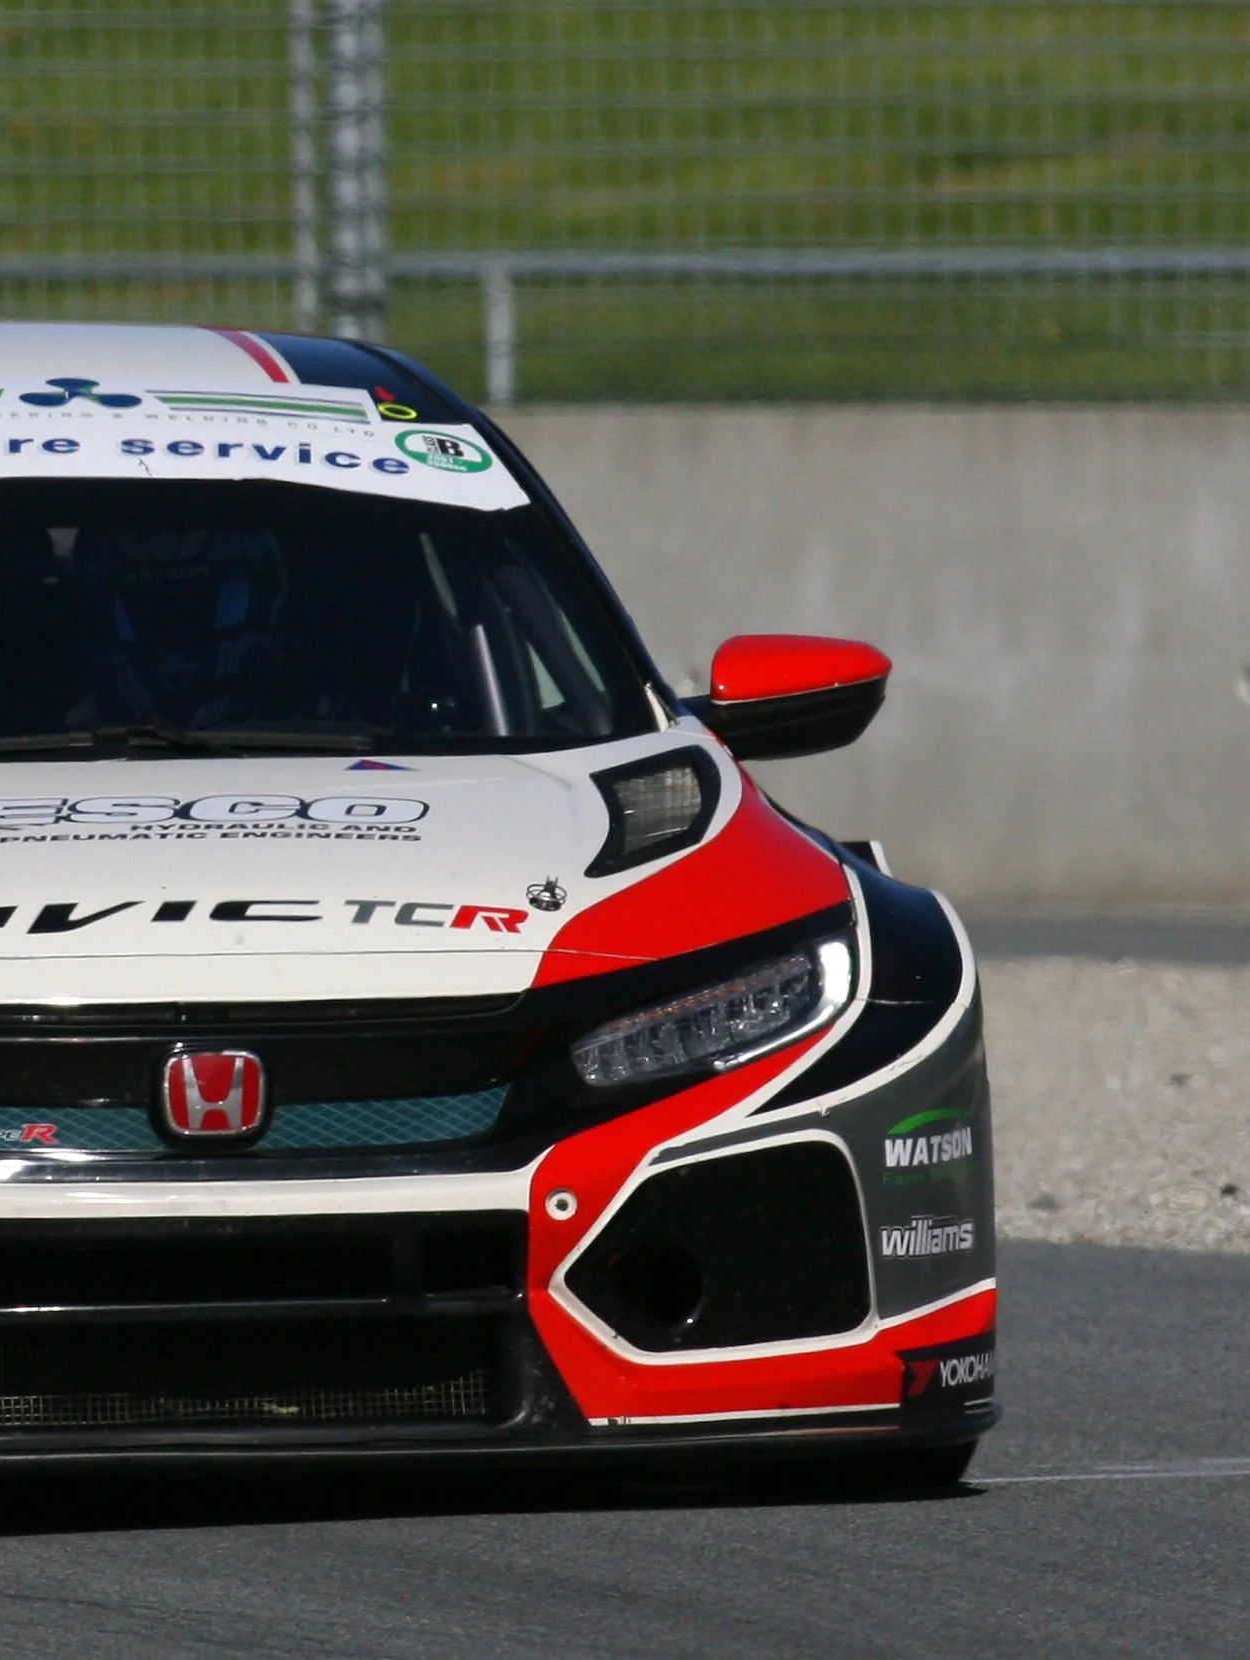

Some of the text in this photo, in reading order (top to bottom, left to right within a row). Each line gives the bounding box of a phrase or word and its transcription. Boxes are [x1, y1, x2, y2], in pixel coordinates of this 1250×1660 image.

[121, 437, 411, 475] service
[130, 823, 418, 833] HYDRAULIC AND
[219, 832, 422, 842] ENGINEERS
[345, 899, 530, 935] TCR
[884, 1127, 973, 1168] WATSON
[881, 1217, 974, 1257] williams
